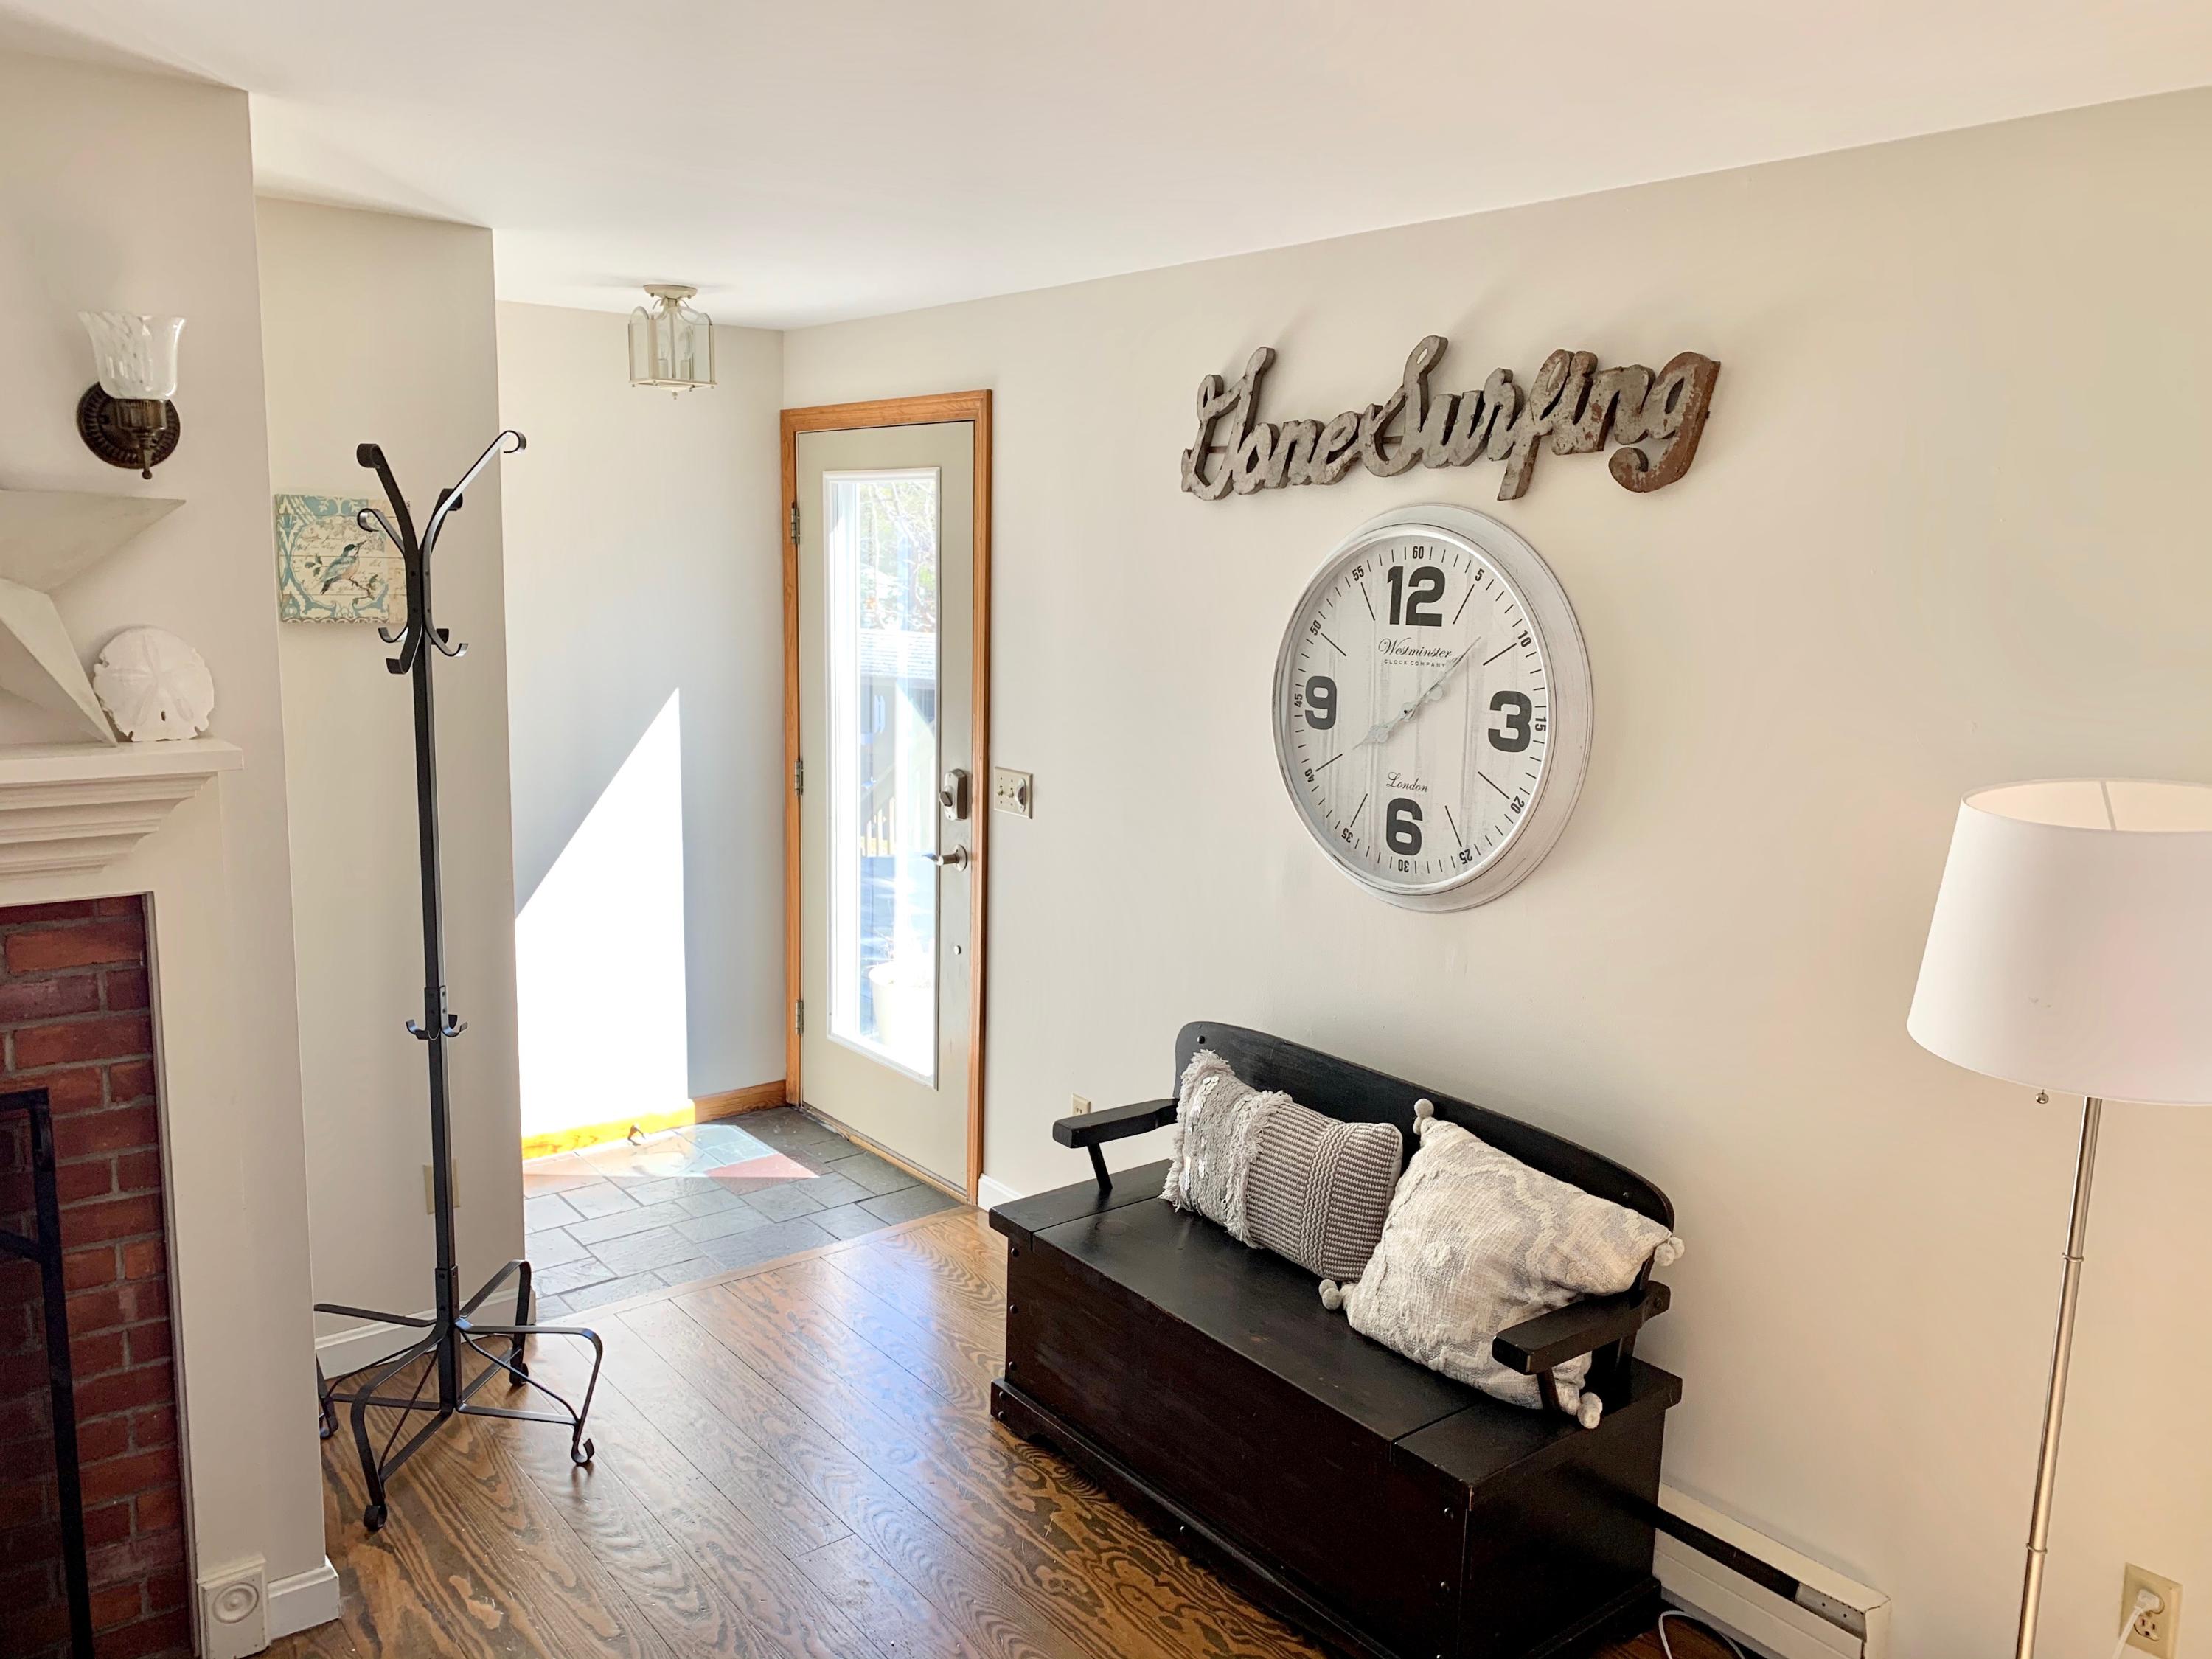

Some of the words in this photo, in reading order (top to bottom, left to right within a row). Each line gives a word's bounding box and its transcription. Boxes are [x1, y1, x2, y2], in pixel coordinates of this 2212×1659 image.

[1412, 546, 1425, 560] 60
[1352, 565, 1366, 582] 55
[1475, 568, 1485, 582] 5
[1387, 566, 1446, 627] 12
[1309, 619, 1321, 636] 50
[1378, 637, 1452, 658] Westminster
[1517, 630, 1532, 648] 10
[1293, 692, 1303, 708] 45
[1304, 675, 1338, 731] 9
[1487, 690, 1532, 753] 3
[1534, 717, 1548, 732] 15
[1304, 768, 1315, 783] 40
[1386, 771, 1428, 792] London
[1510, 796, 1525, 814] 20
[1385, 797, 1423, 856] 6
[1340, 827, 1354, 844] 35
[1458, 848, 1473, 865] 25
[1397, 859, 1410, 873] 30
